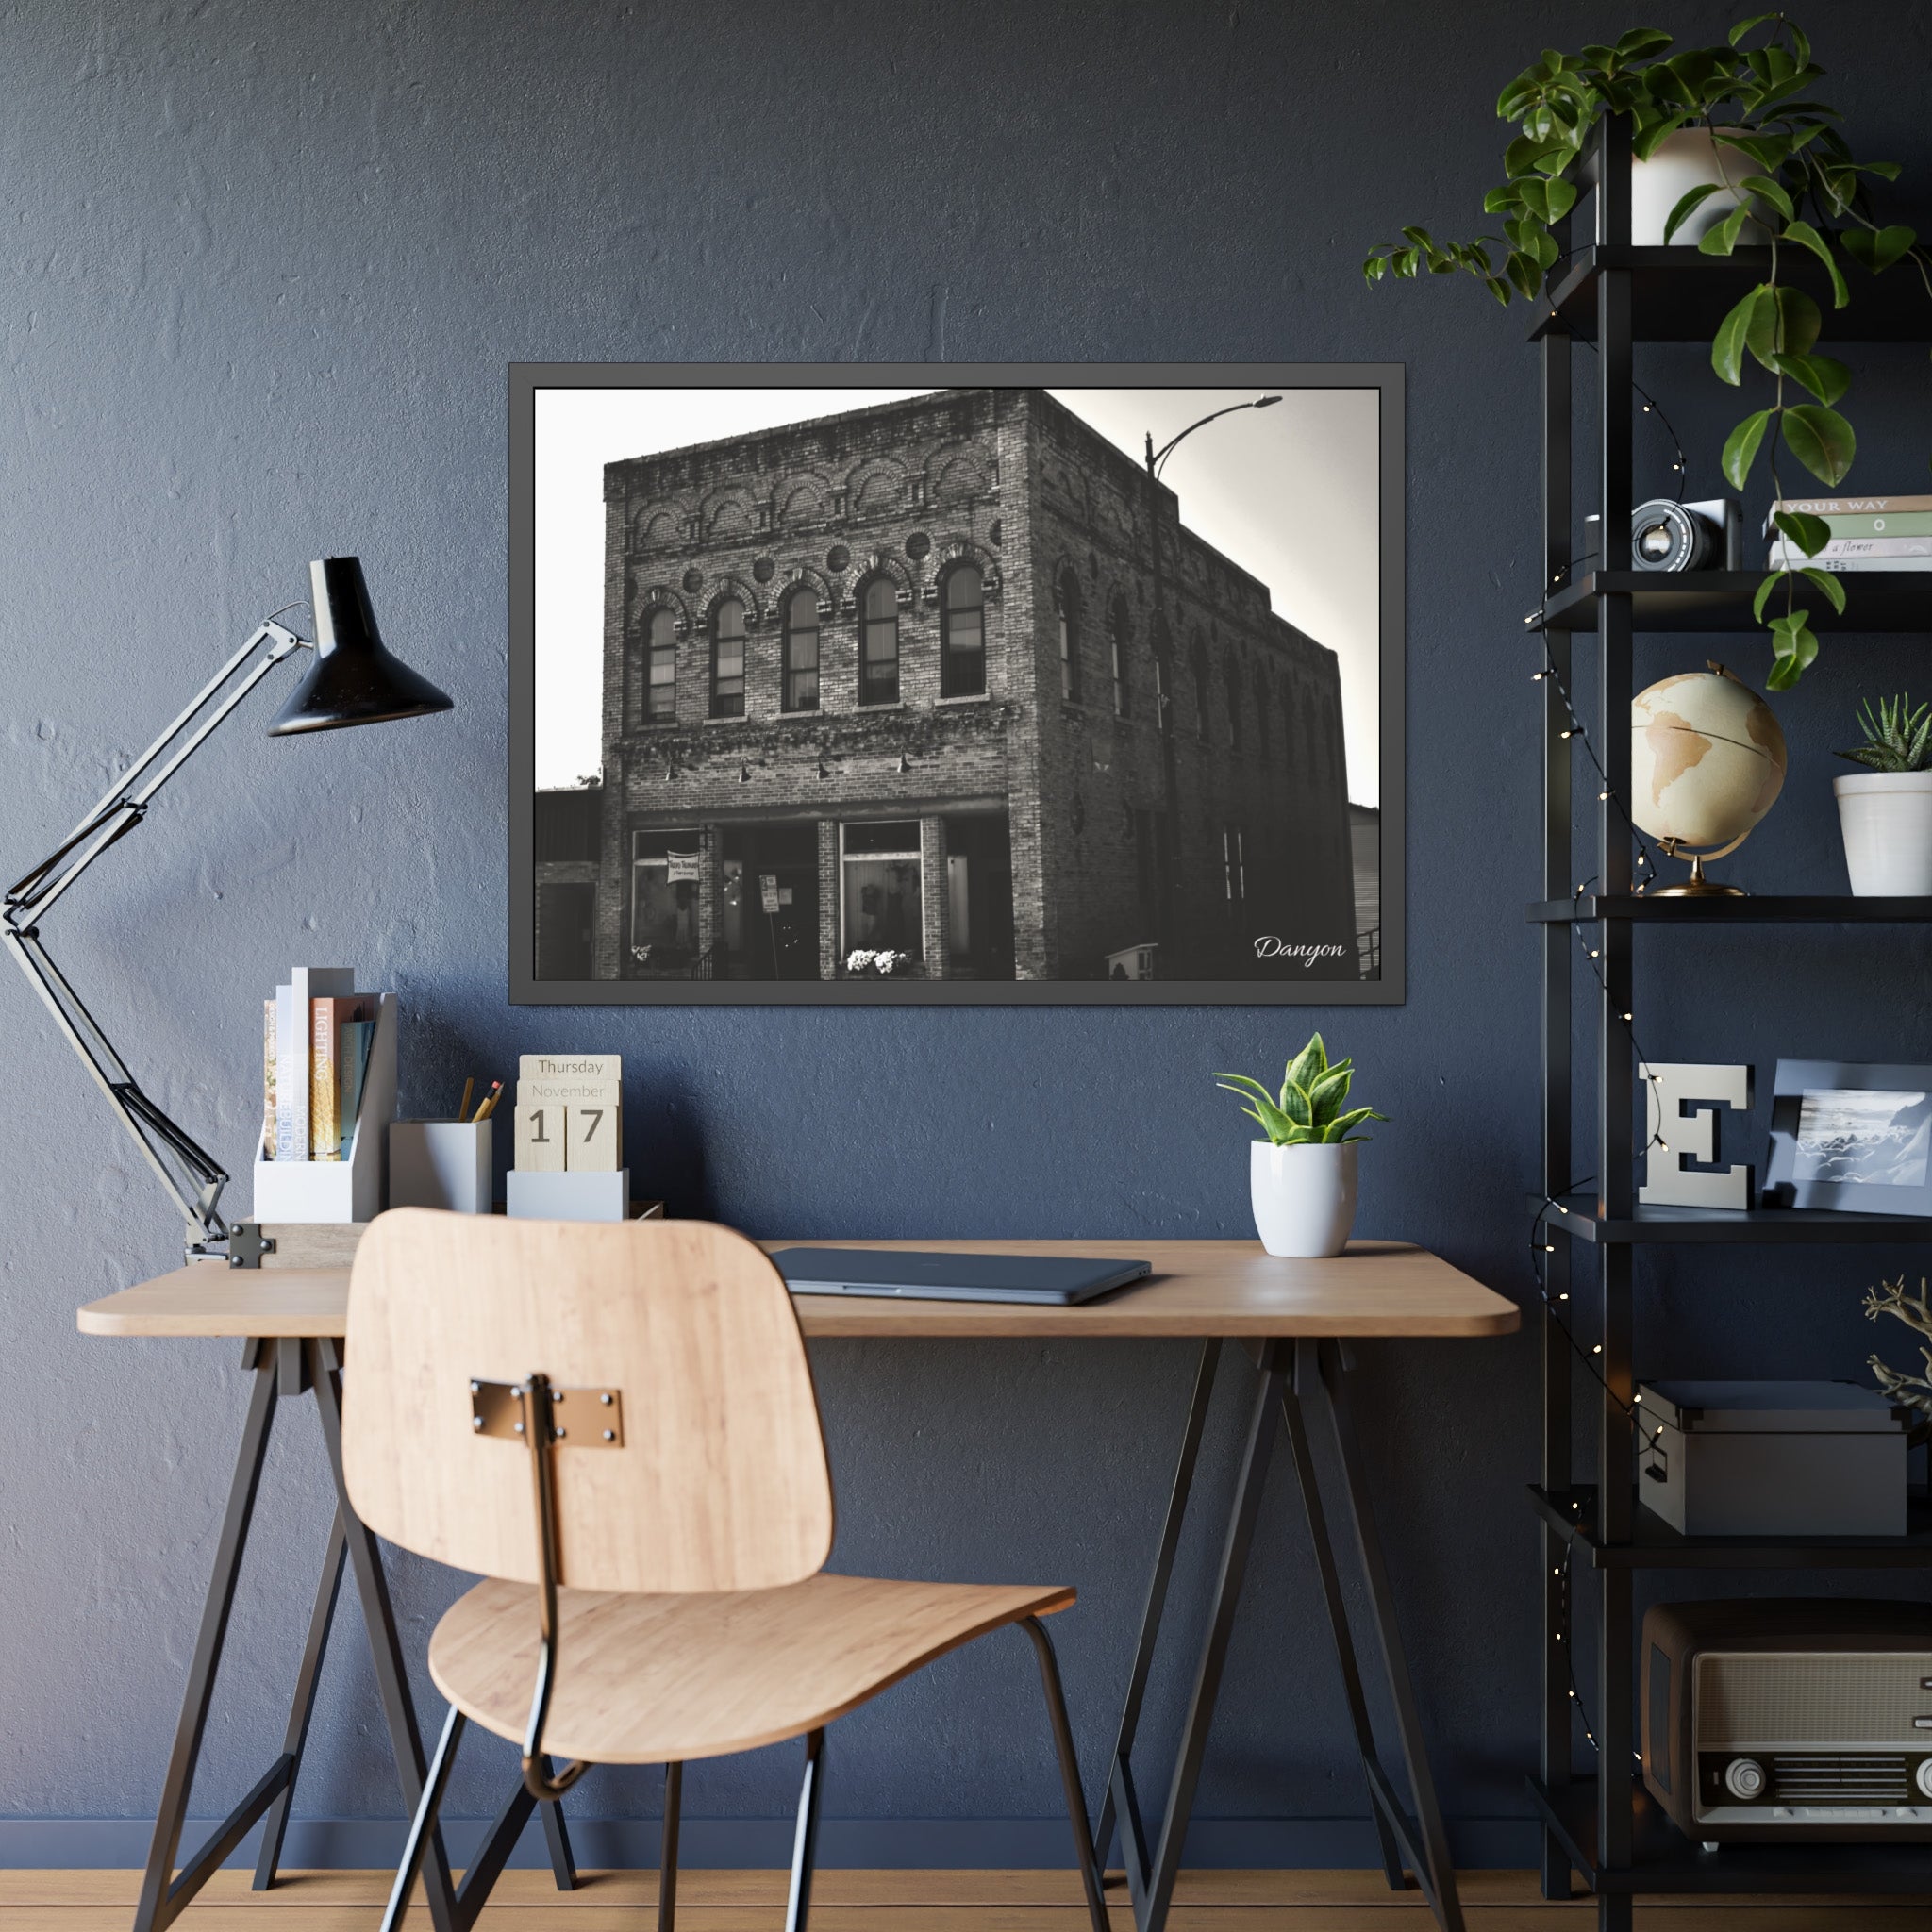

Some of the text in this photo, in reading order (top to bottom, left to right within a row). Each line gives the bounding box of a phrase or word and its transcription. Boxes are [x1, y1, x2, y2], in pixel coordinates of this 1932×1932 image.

[1786, 500, 1889, 513] YOUR WAY
[1840, 541, 1874, 557] flower
[1254, 935, 1347, 968] Danyon
[314, 1007, 328, 1081] LIGHTING
[539, 1059, 605, 1075] Thursday
[532, 1085, 605, 1098] November
[295, 1105, 307, 1160] MODERN
[1639, 1062, 1748, 1210] E
